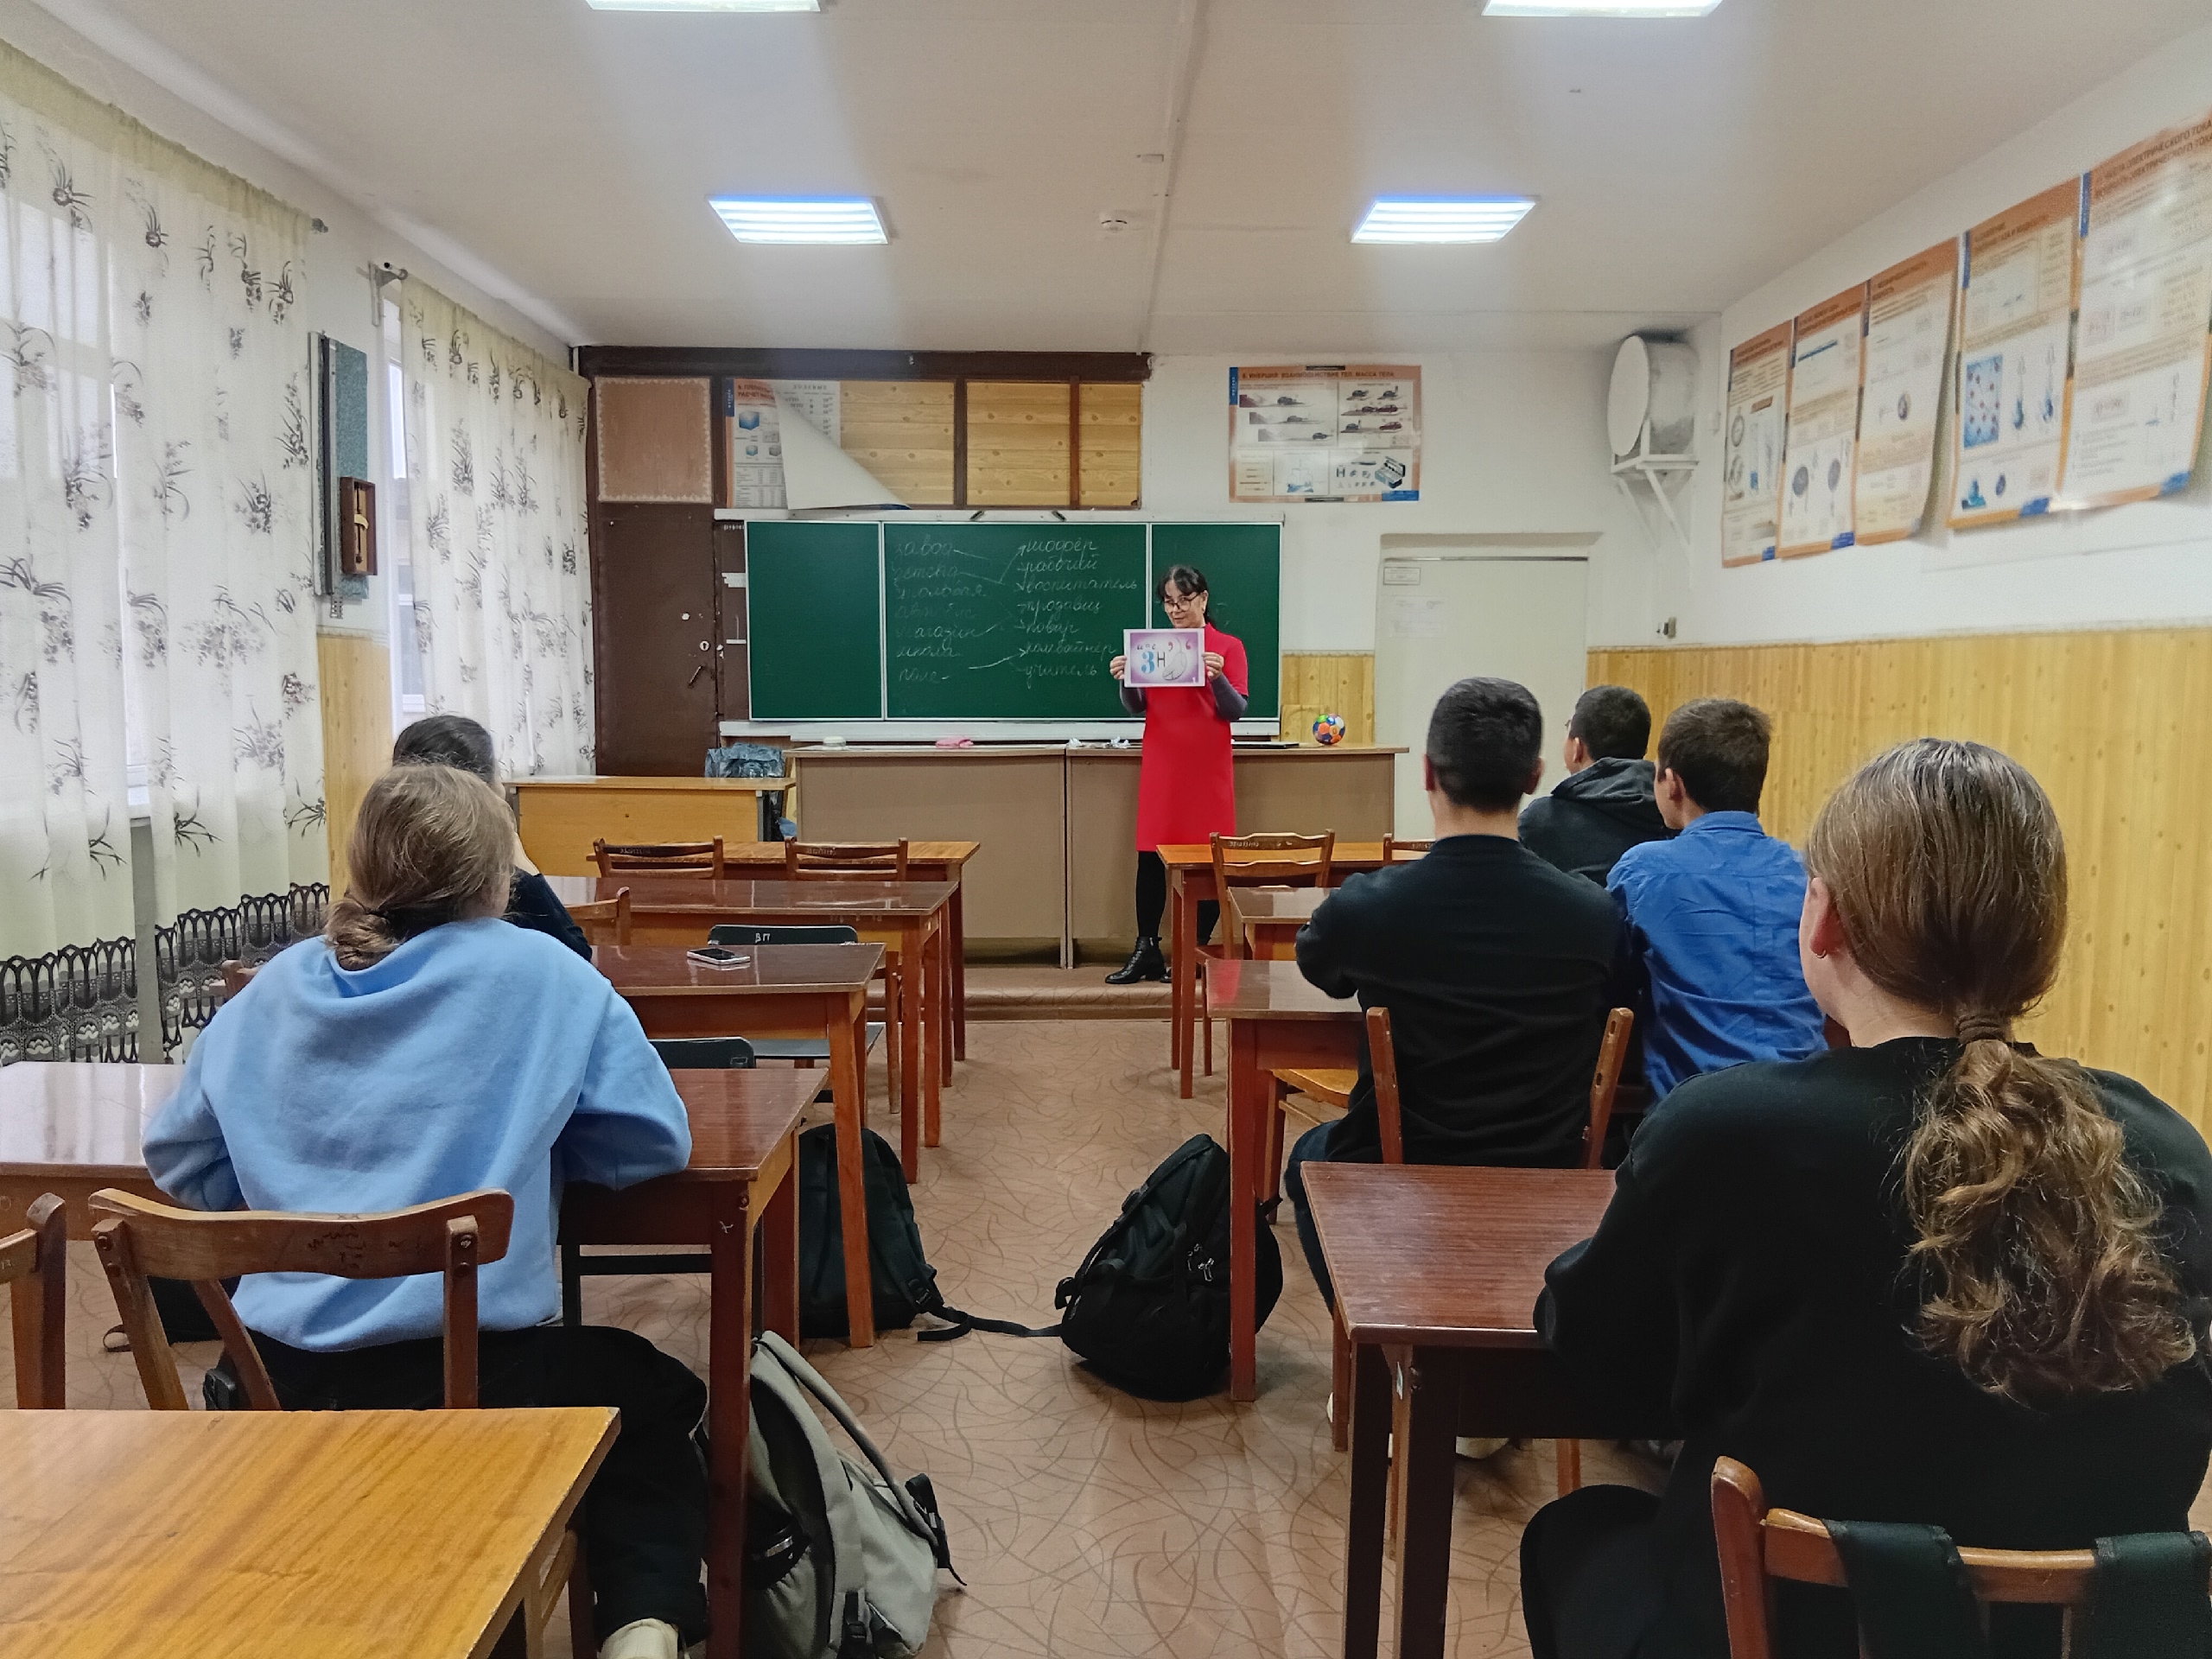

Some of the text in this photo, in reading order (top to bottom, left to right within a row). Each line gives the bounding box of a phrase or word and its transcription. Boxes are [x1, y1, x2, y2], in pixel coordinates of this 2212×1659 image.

[2191, 119, 2212, 136] ТОКА
[894, 533, 952, 563] завод
[1024, 554, 1101, 586] рабочий
[1026, 574, 1138, 594] воспитатель
[1026, 614, 1080, 642] повар
[1025, 664, 1098, 690] учитель
